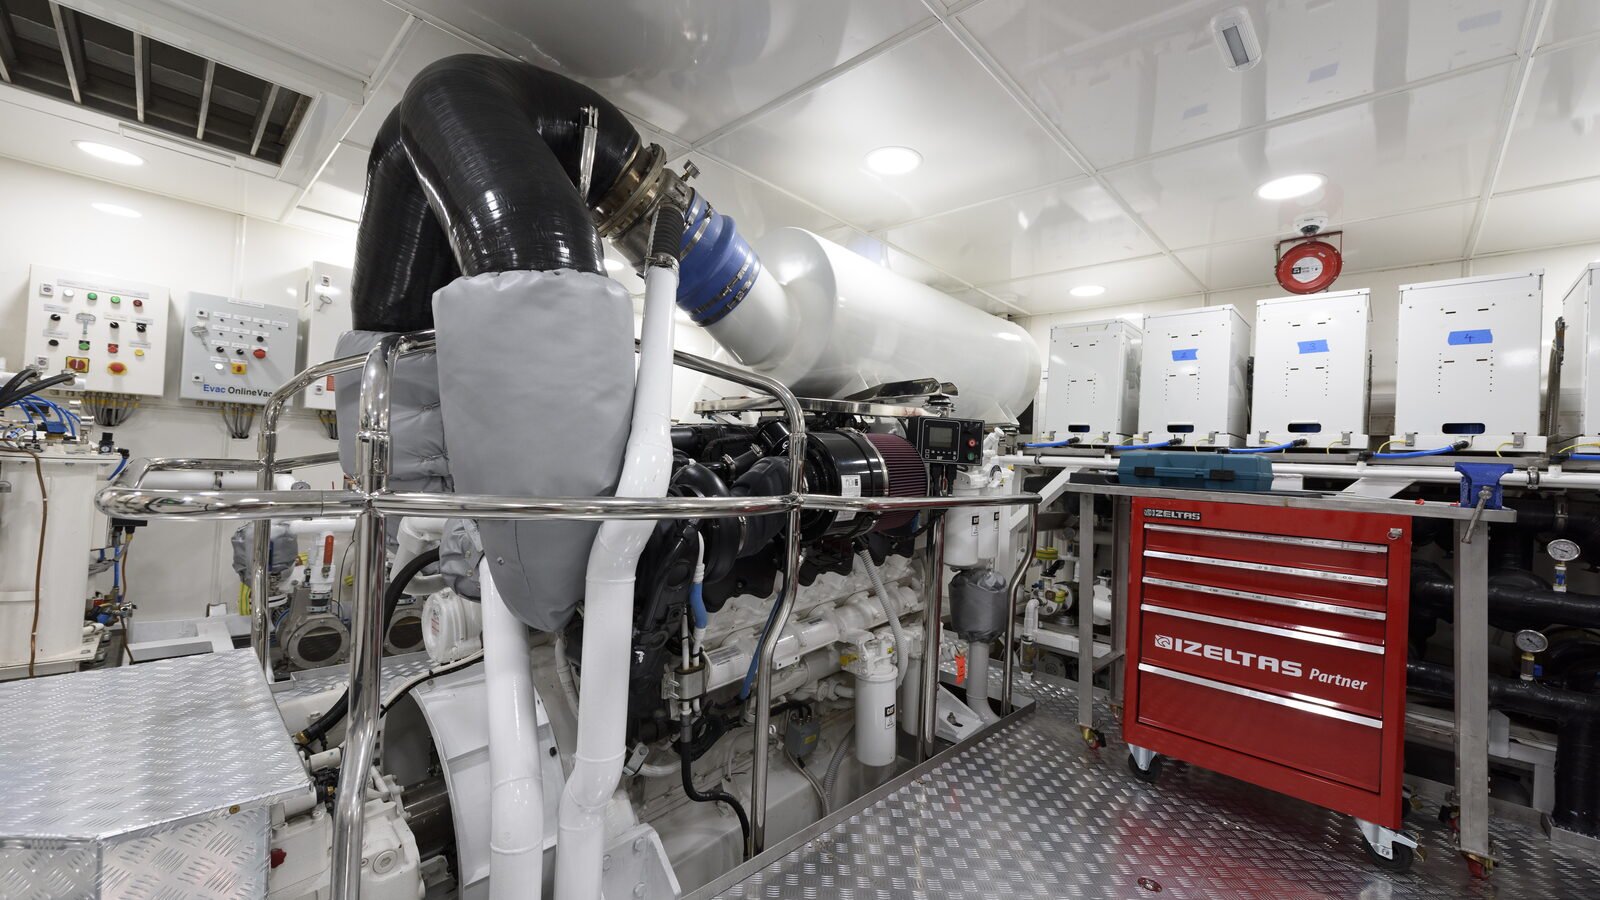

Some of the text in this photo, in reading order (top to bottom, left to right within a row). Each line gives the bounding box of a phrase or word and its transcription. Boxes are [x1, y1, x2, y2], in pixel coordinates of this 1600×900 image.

[203, 384, 226, 393] Evac
[1152, 509, 1200, 520] IZELTAS
[1175, 638, 1368, 690] IZELTAS Partner
